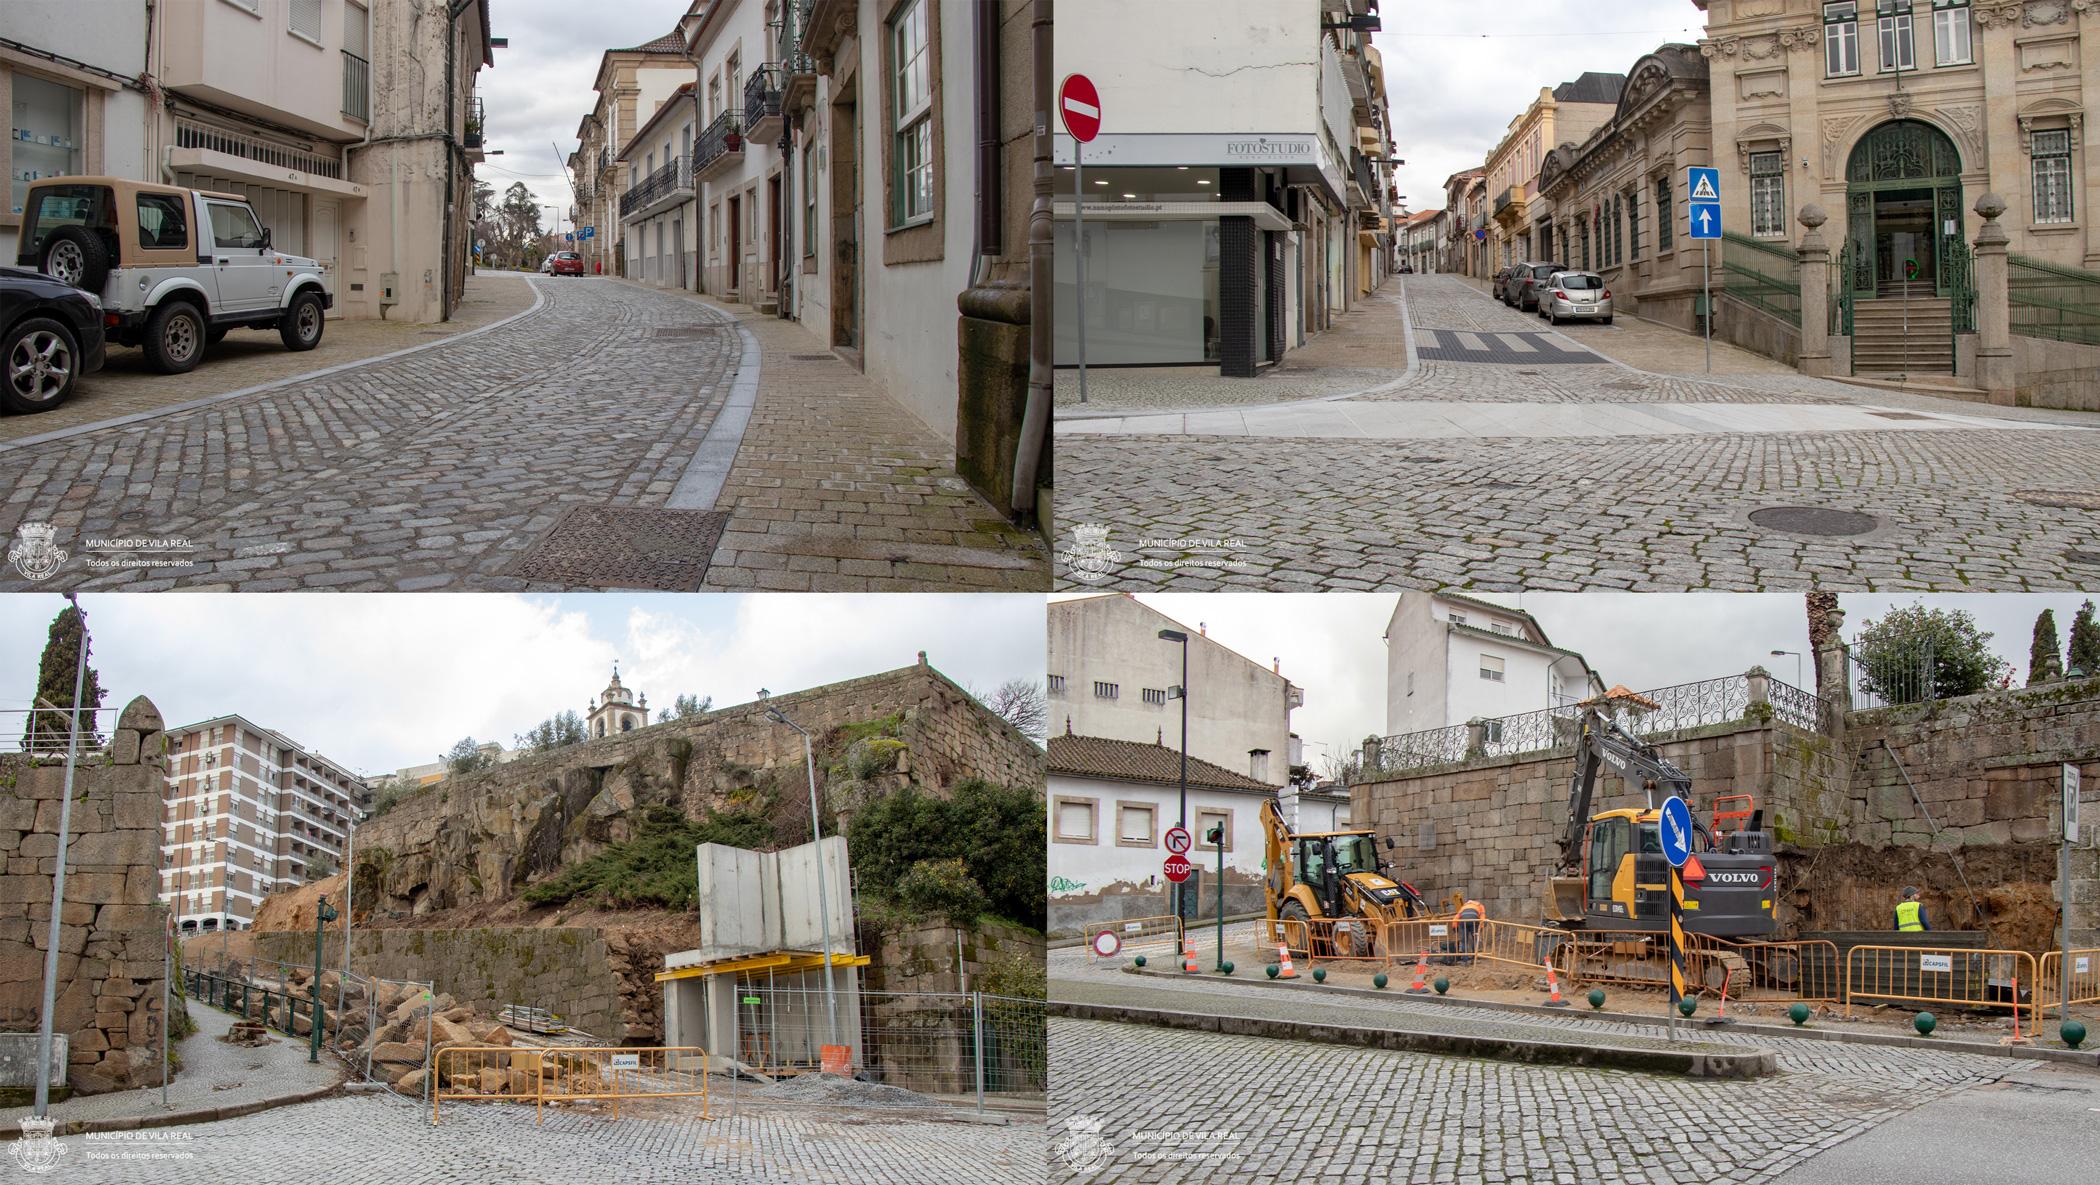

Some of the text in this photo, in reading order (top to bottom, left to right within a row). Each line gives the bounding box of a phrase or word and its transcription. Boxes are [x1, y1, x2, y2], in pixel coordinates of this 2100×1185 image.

[1227, 143, 1311, 154] FOTOSTUDIO
[1601, 747, 1626, 770] VOLVO
[1164, 863, 1190, 874] STOP
[1708, 873, 1759, 883] VOLVO
[1380, 888, 1401, 896] CAT
